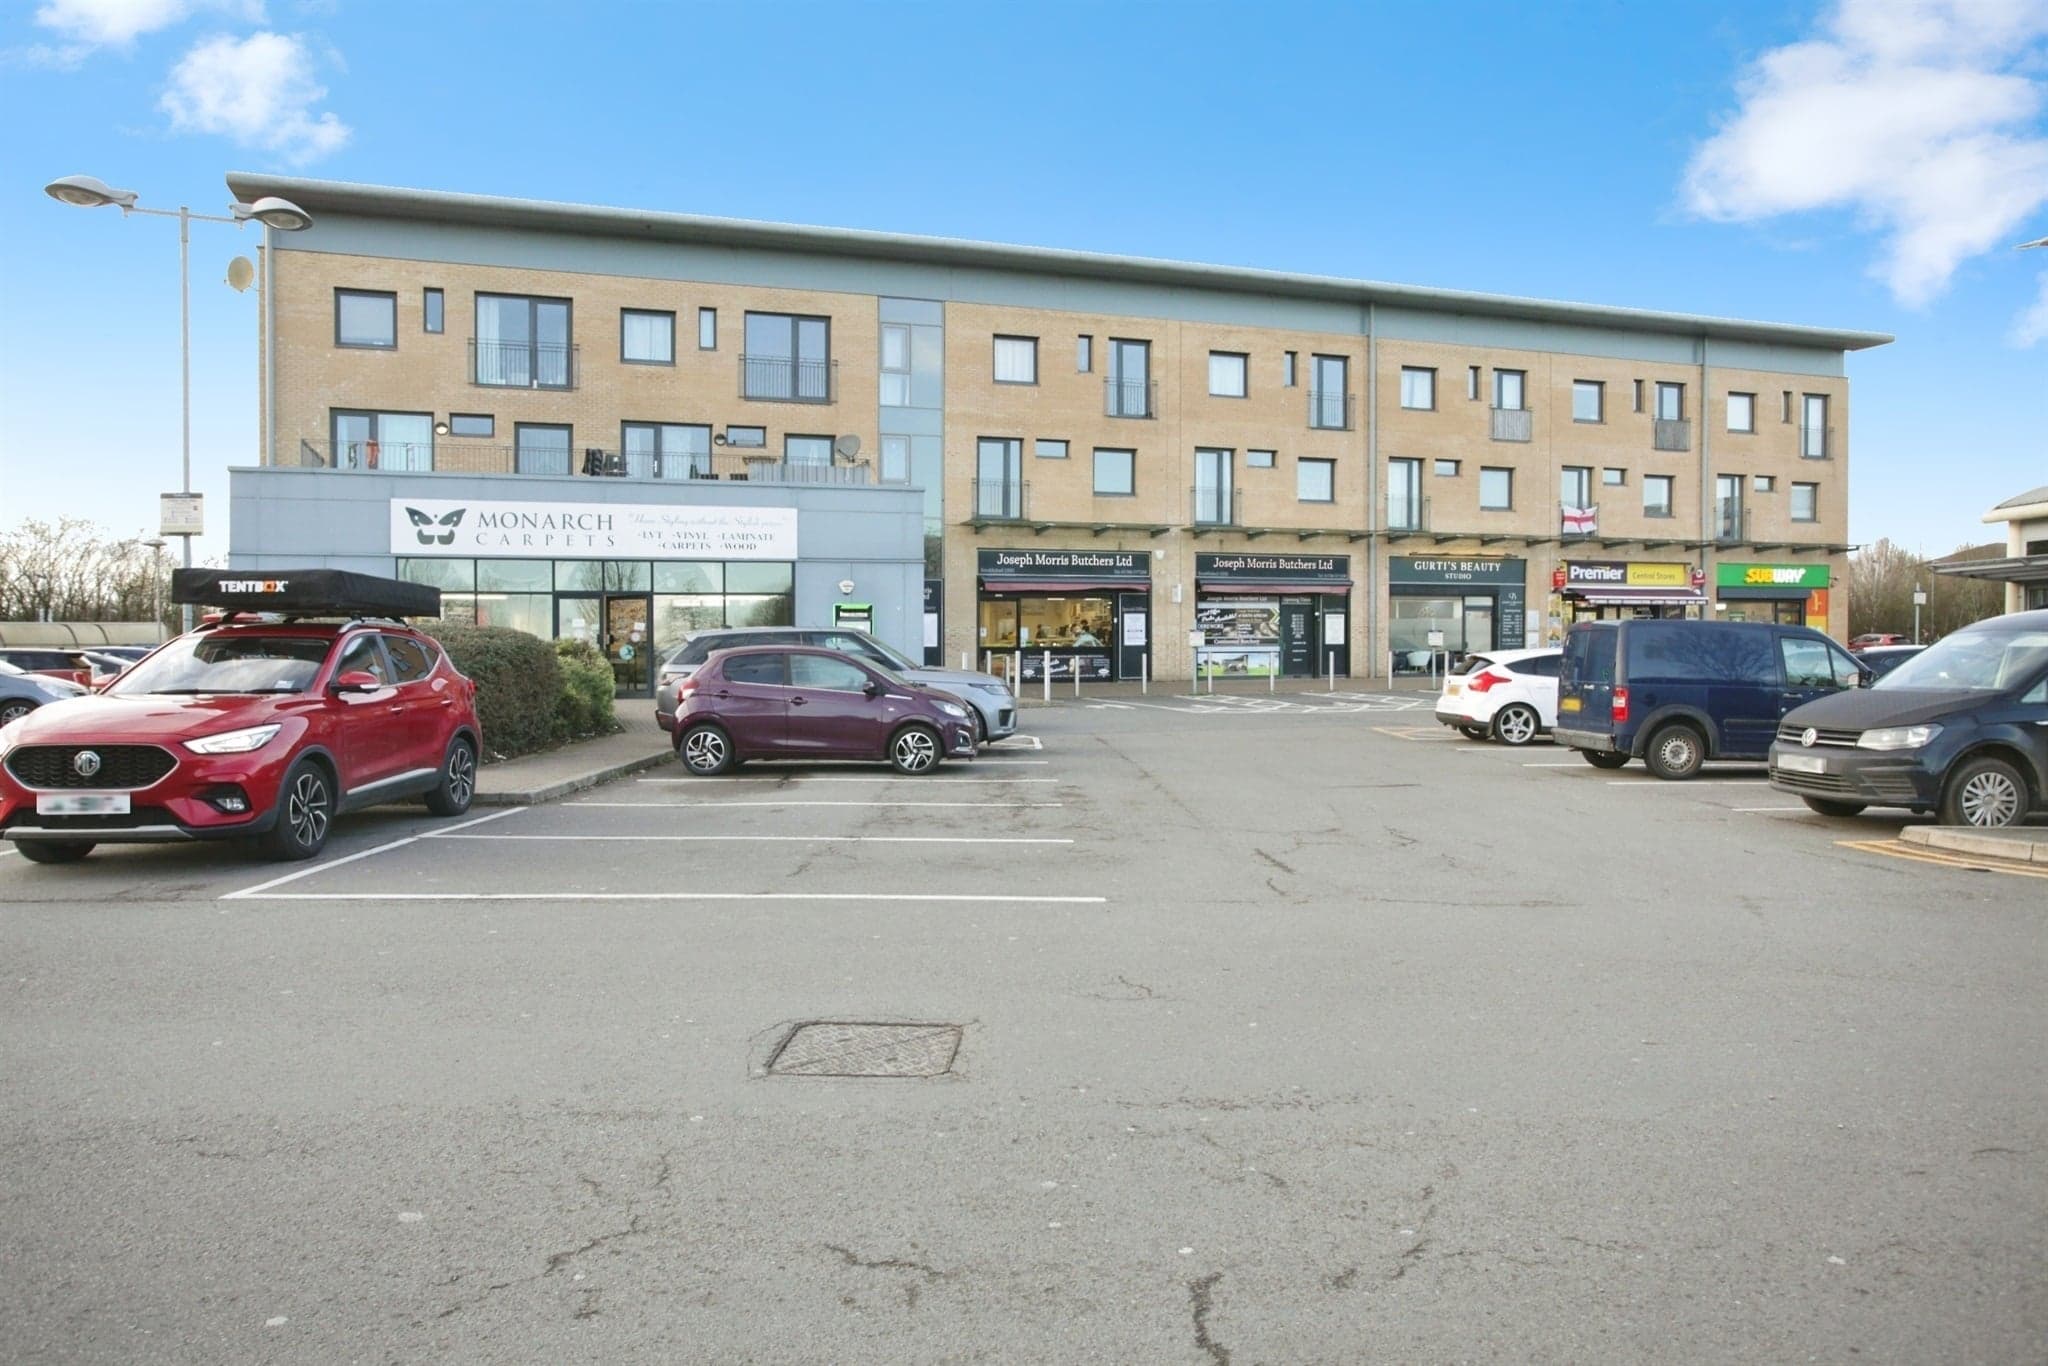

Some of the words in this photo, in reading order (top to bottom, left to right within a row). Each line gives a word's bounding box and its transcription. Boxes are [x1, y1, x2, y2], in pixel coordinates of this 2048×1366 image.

[478, 511, 612, 531] MONARCH
[476, 533, 614, 547] CARPETS
[997, 553, 1033, 568] Joseph
[1035, 554, 1069, 566] Morris
[1071, 554, 1114, 567] Butchers
[1116, 555, 1132, 567] Ltd
[1213, 557, 1245, 571] Joseph
[1247, 558, 1277, 569] Morris
[1279, 558, 1317, 570] Butchers
[1318, 559, 1333, 570] Ltd
[1414, 560, 1457, 571] GURTI'S
[1460, 561, 1501, 572] BEAUTY
[1444, 572, 1472, 580] STUDIO
[1570, 565, 1624, 580] Premier
[1632, 571, 1654, 580] Central
[1656, 572, 1676, 581] Stores
[1744, 568, 1806, 584] SUBWAY
